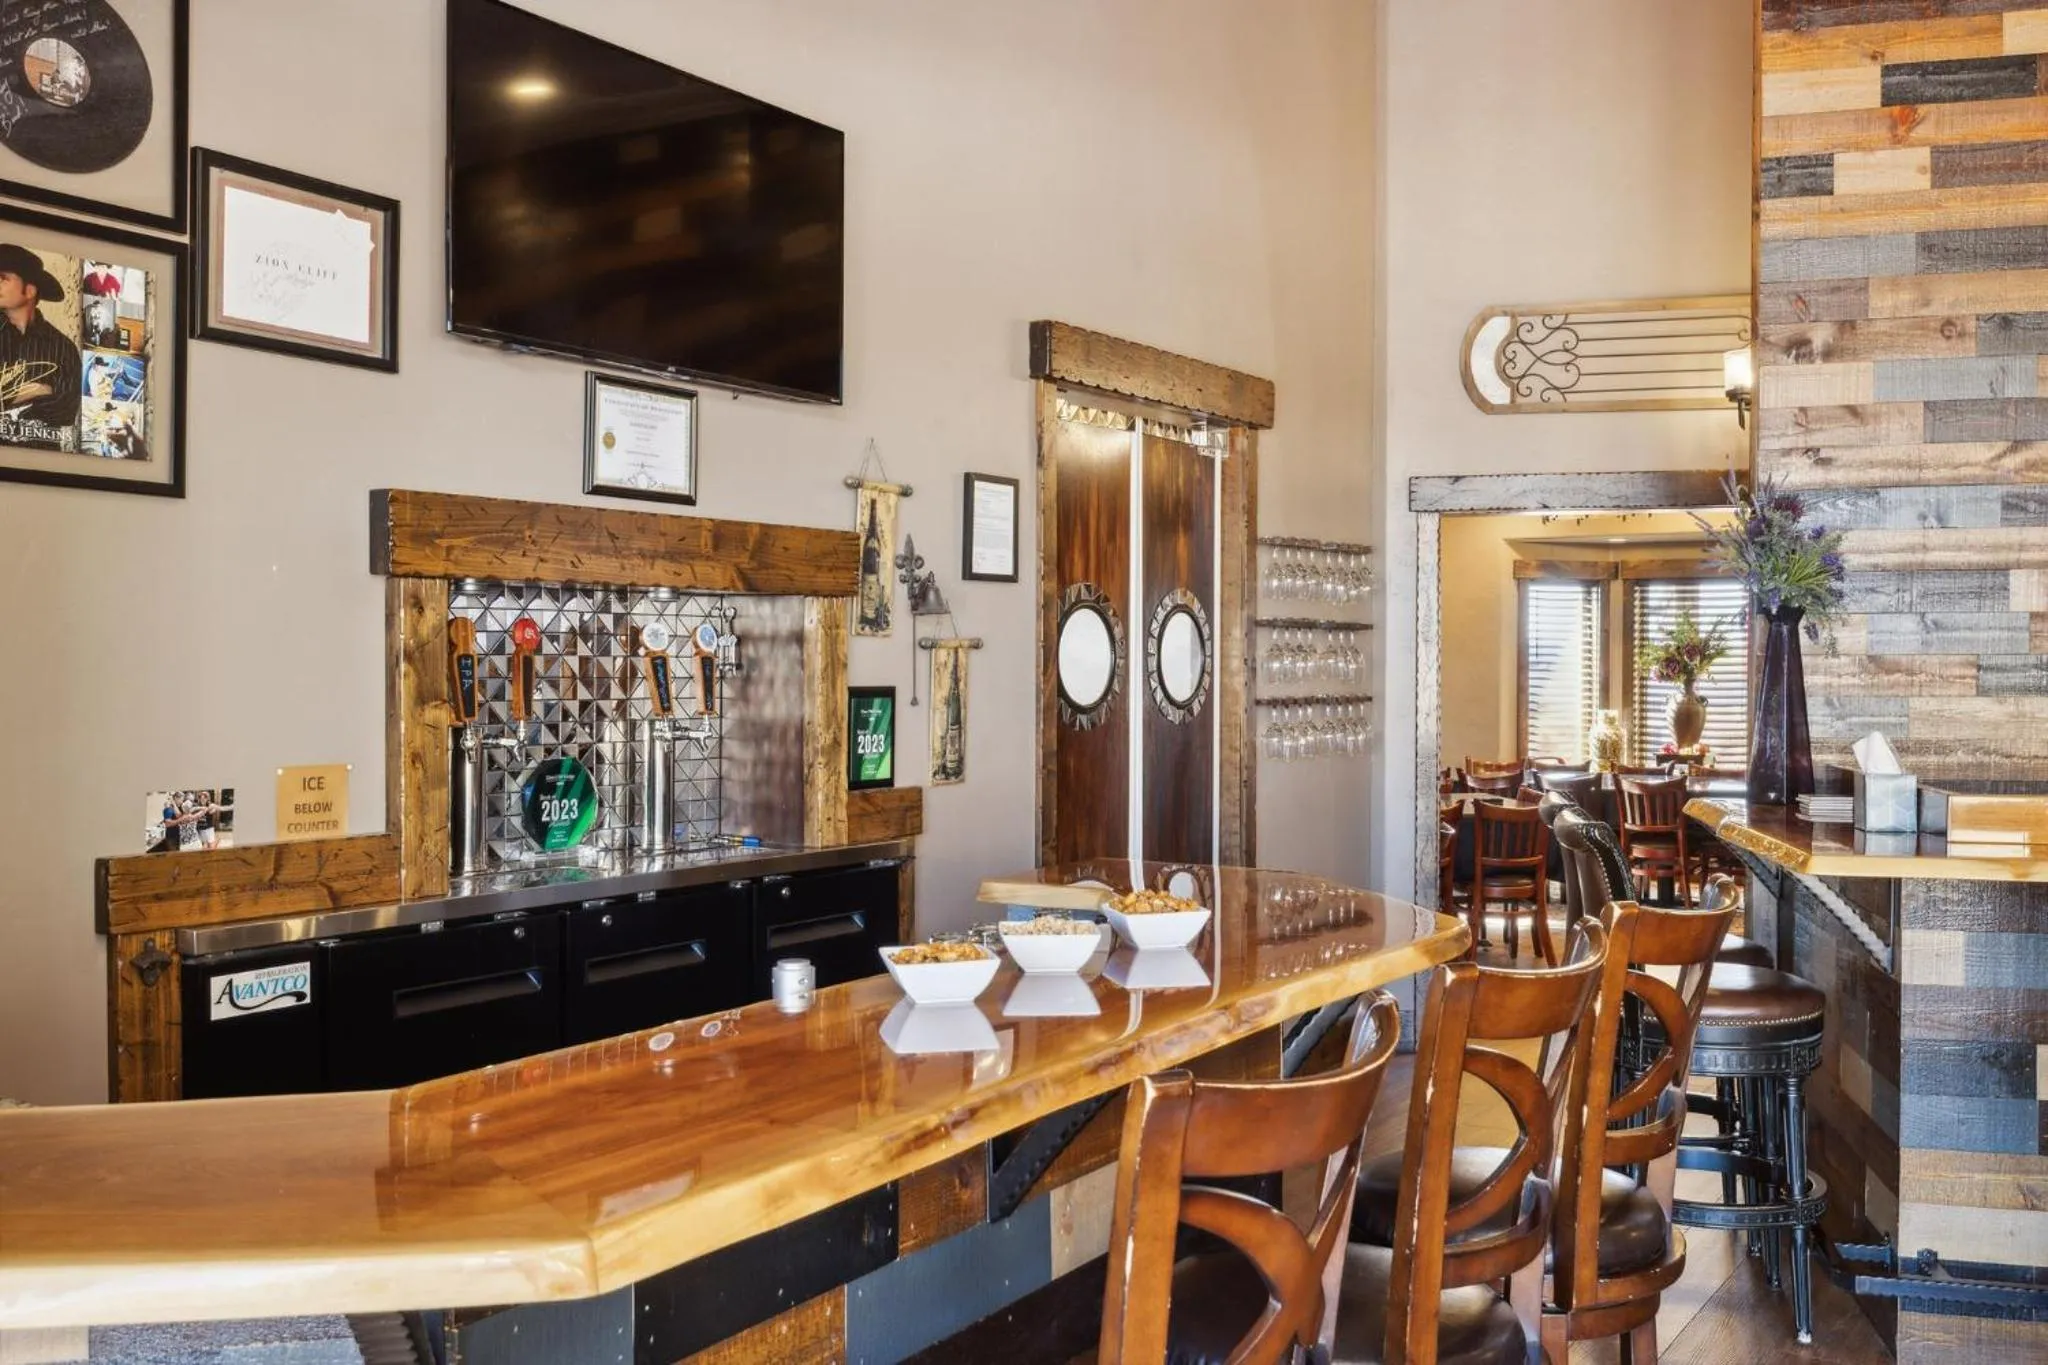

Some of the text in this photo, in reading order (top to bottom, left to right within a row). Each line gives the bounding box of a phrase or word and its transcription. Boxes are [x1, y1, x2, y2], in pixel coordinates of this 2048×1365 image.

[19, 425, 73, 442] JENKINS
[856, 733, 886, 754] 2023
[302, 776, 325, 792] ICE
[294, 801, 333, 814] BELOW
[541, 798, 579, 822] 2023
[287, 820, 339, 834] COUNTER
